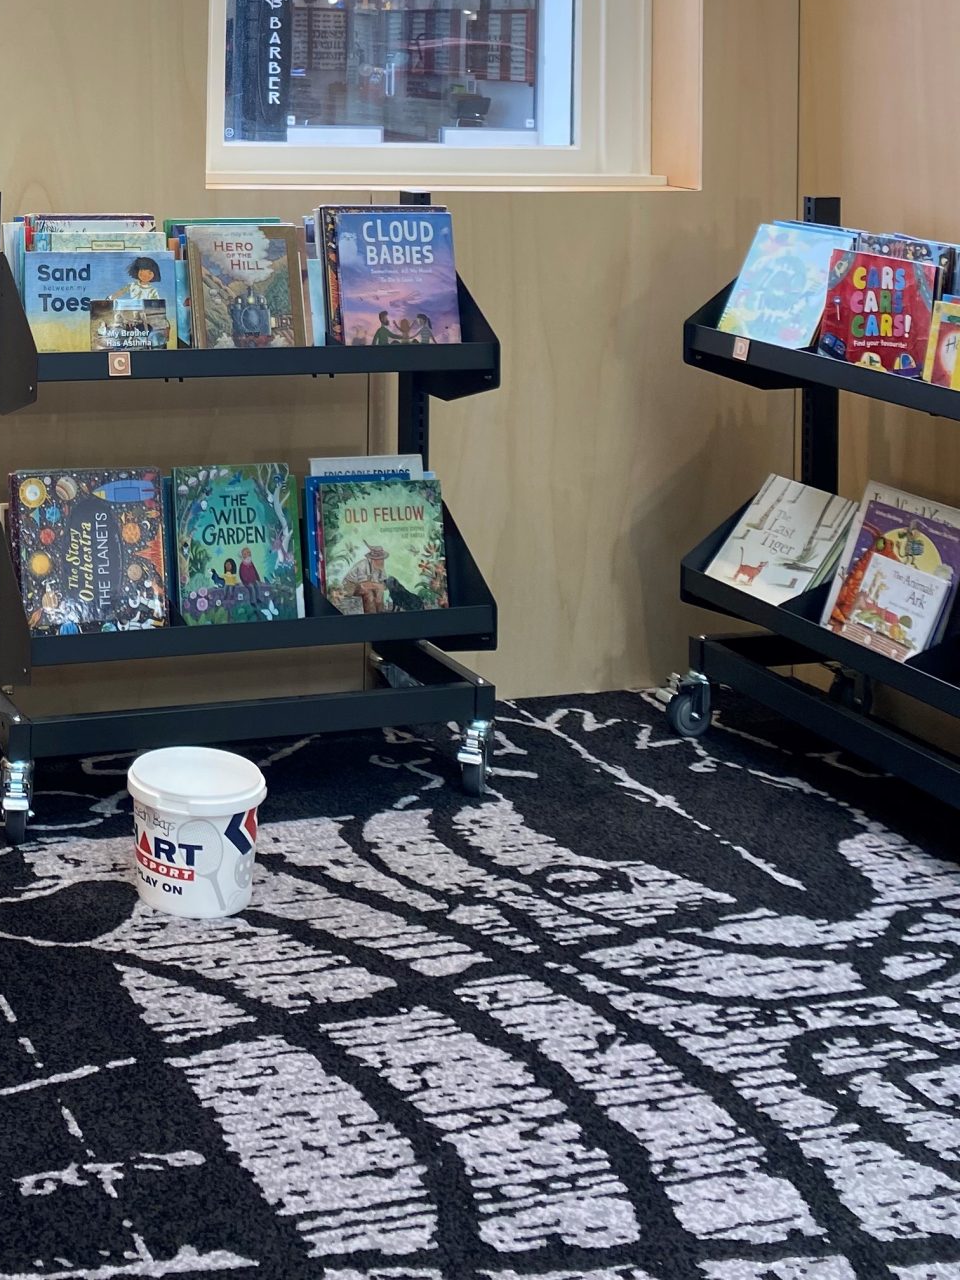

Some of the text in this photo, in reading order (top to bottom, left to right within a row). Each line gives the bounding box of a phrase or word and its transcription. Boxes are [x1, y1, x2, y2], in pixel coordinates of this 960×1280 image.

[268, 16, 282, 105] BARBER
[362, 219, 434, 243] CLOUD
[214, 241, 254, 252] HERO
[366, 245, 434, 266] BABIES
[37, 263, 91, 282] Sand
[230, 259, 265, 271] HILL
[43, 284, 87, 293] between my
[852, 265, 906, 291] CARS
[38, 293, 91, 313] Toes
[849, 289, 904, 314] CARS
[107, 329, 150, 339] My Brother
[850, 313, 912, 339] CARS!
[106, 338, 152, 348] Has Asthma
[853, 339, 866, 348] Find
[866, 340, 880, 349] your
[218, 492, 249, 507] THE
[210, 506, 257, 525] WILD
[344, 505, 425, 524] OLD FELLOW
[202, 524, 266, 546] GARDEN
[767, 518, 796, 539] Last
[760, 531, 796, 556] Tiger
[65, 528, 82, 590] The Story
[78, 522, 95, 602] Orchestra
[95, 512, 112, 609] THE PLANETS
[142, 857, 193, 881] SPORT
[162, 883, 183, 896] ON
